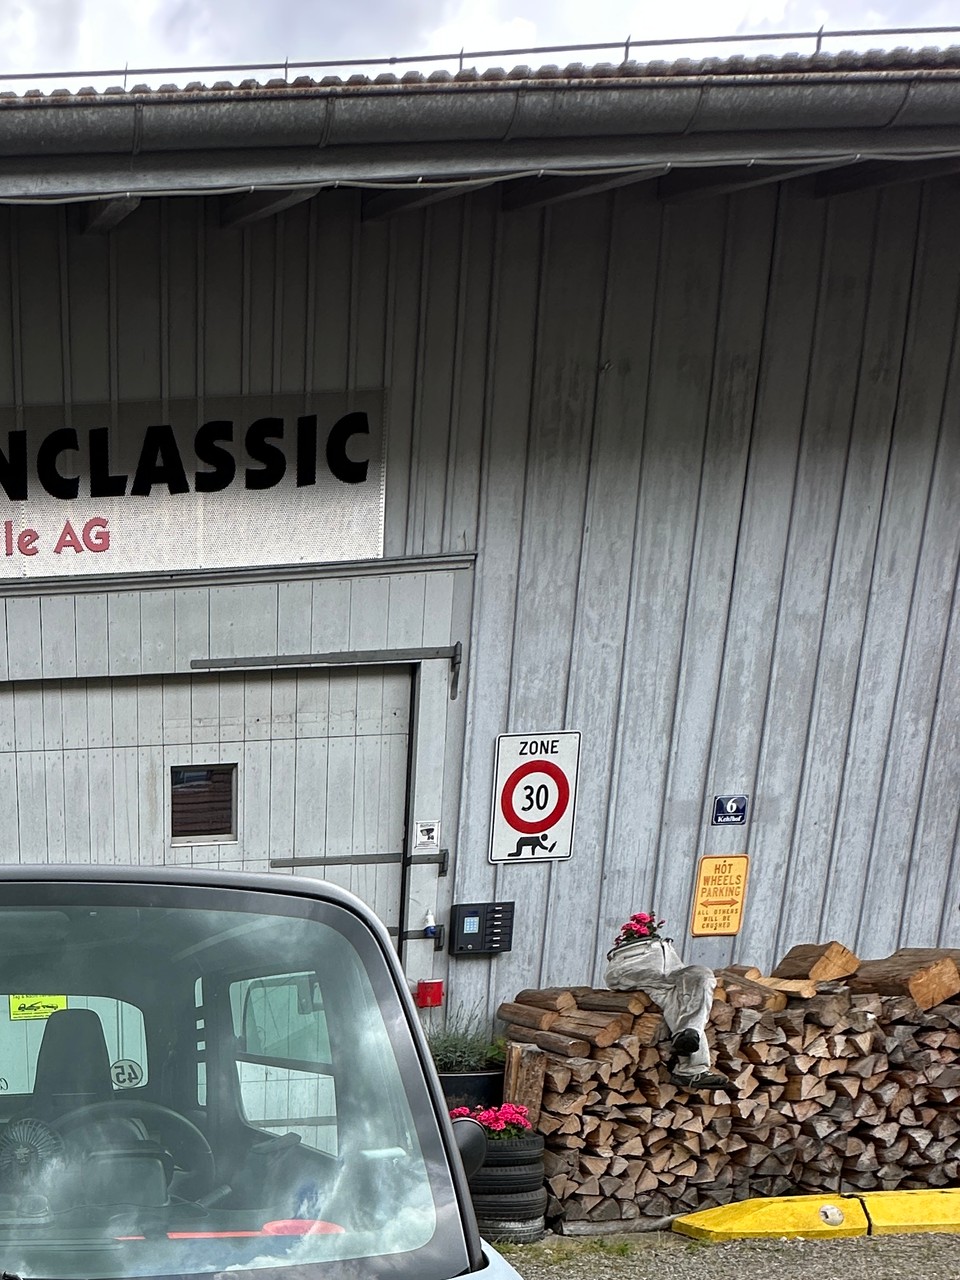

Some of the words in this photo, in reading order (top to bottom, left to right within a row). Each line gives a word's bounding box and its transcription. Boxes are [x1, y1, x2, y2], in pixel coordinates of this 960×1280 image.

[53, 516, 111, 555] AG
[519, 740, 560, 756] ZONE
[521, 784, 549, 811] 30
[726, 797, 737, 813] 6
[714, 863, 733, 875] HOT
[703, 875, 742, 886] WHEELS
[700, 886, 741, 898] PARKING
